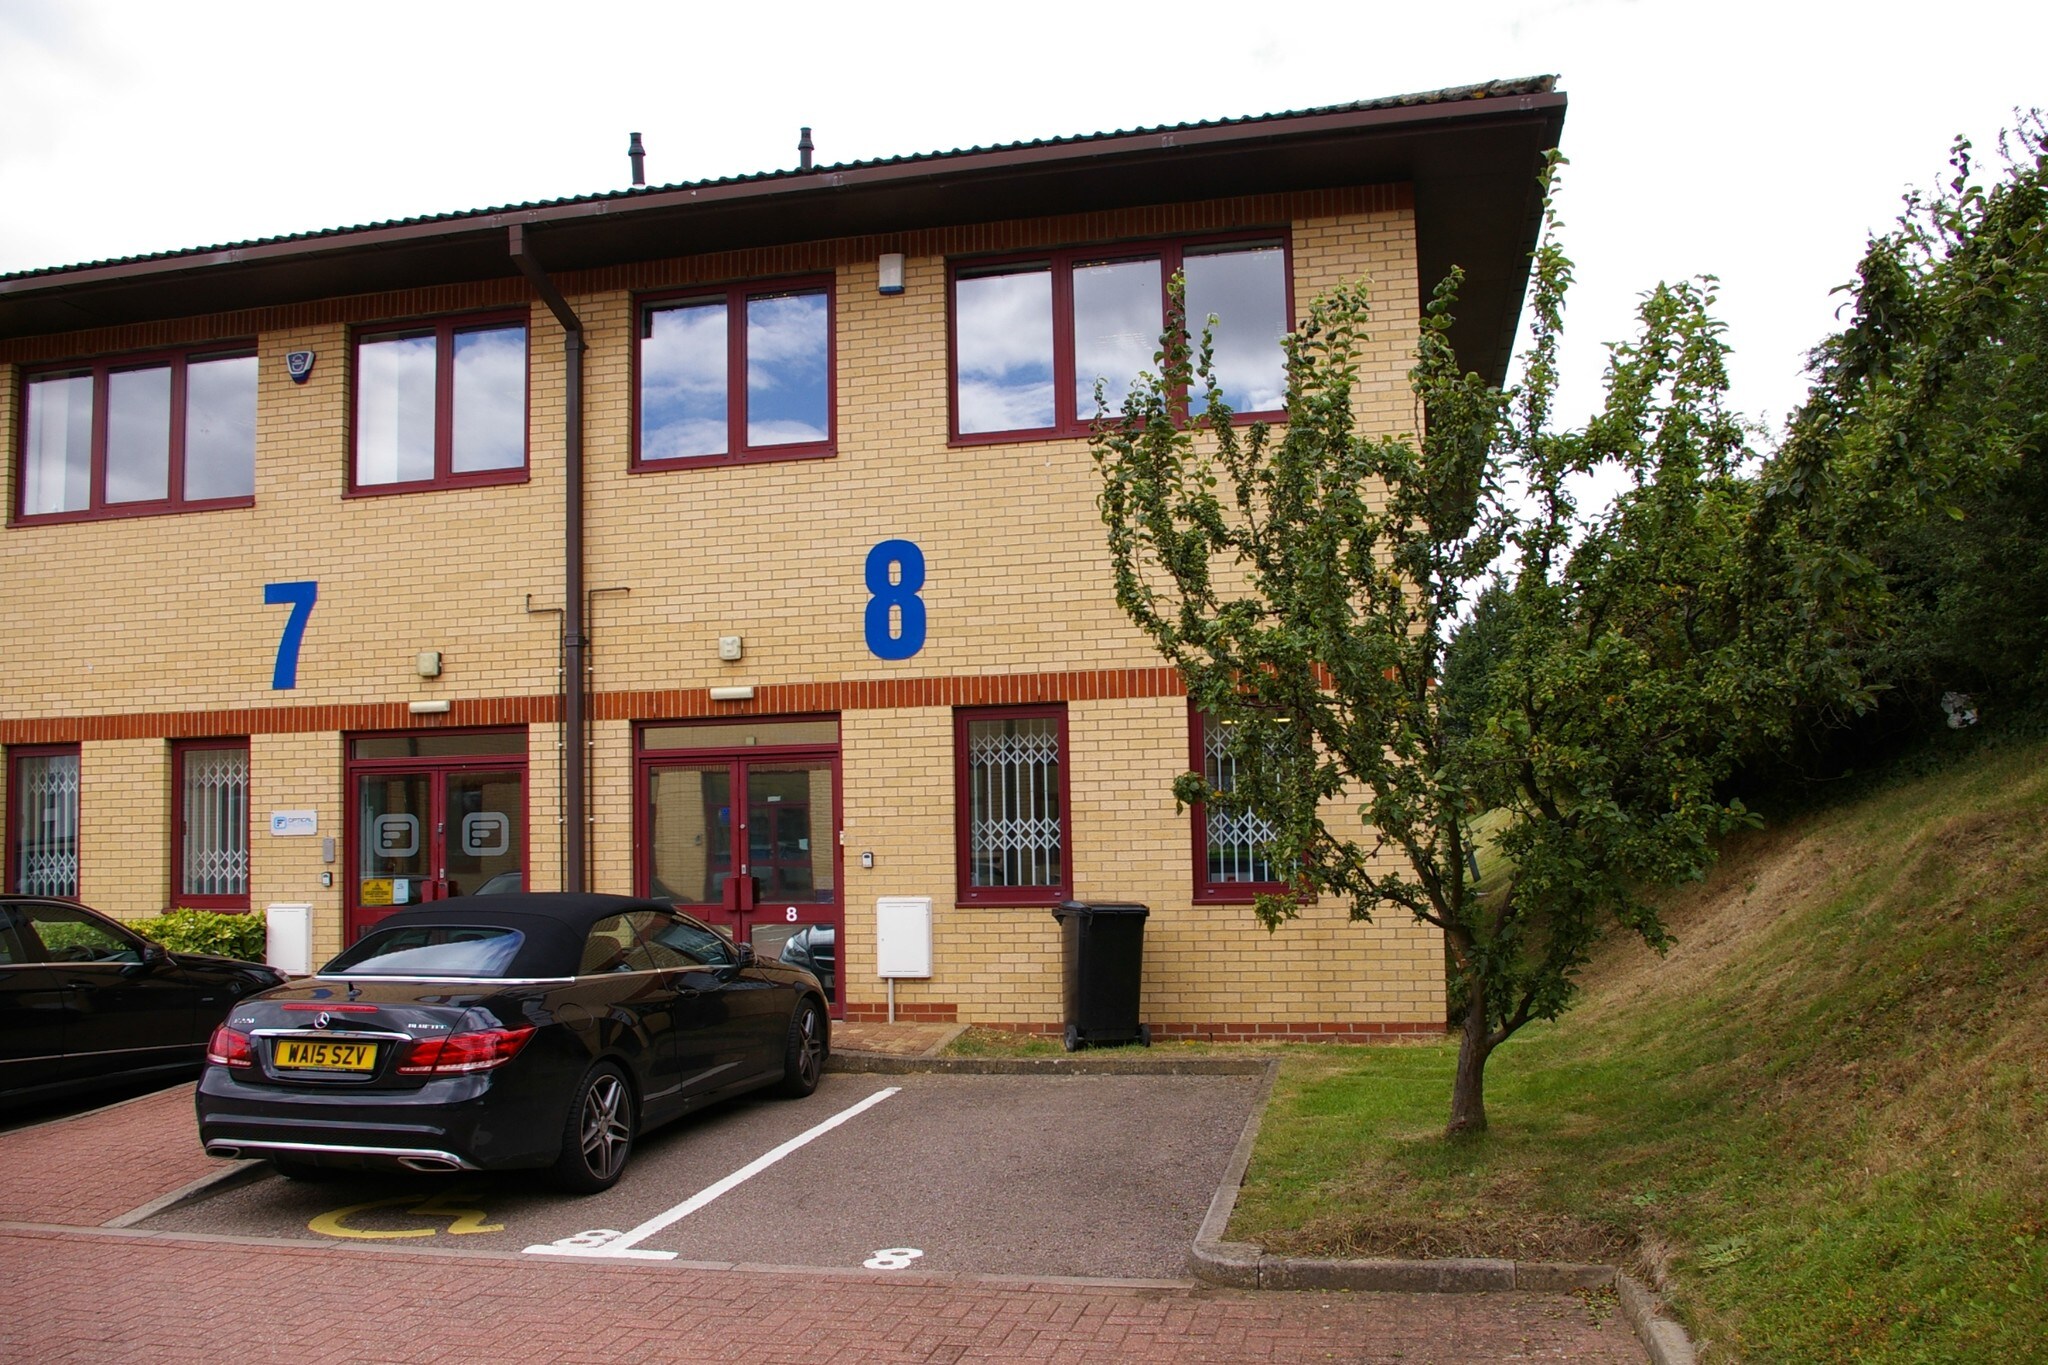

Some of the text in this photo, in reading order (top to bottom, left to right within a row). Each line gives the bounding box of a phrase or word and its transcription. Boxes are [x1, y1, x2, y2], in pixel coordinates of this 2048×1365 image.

[865, 540, 925, 659] 8
[264, 582, 317, 690] 7
[786, 907, 798, 922] 8
[288, 1044, 366, 1065] WA15 SZV
[863, 1248, 924, 1270] 8
